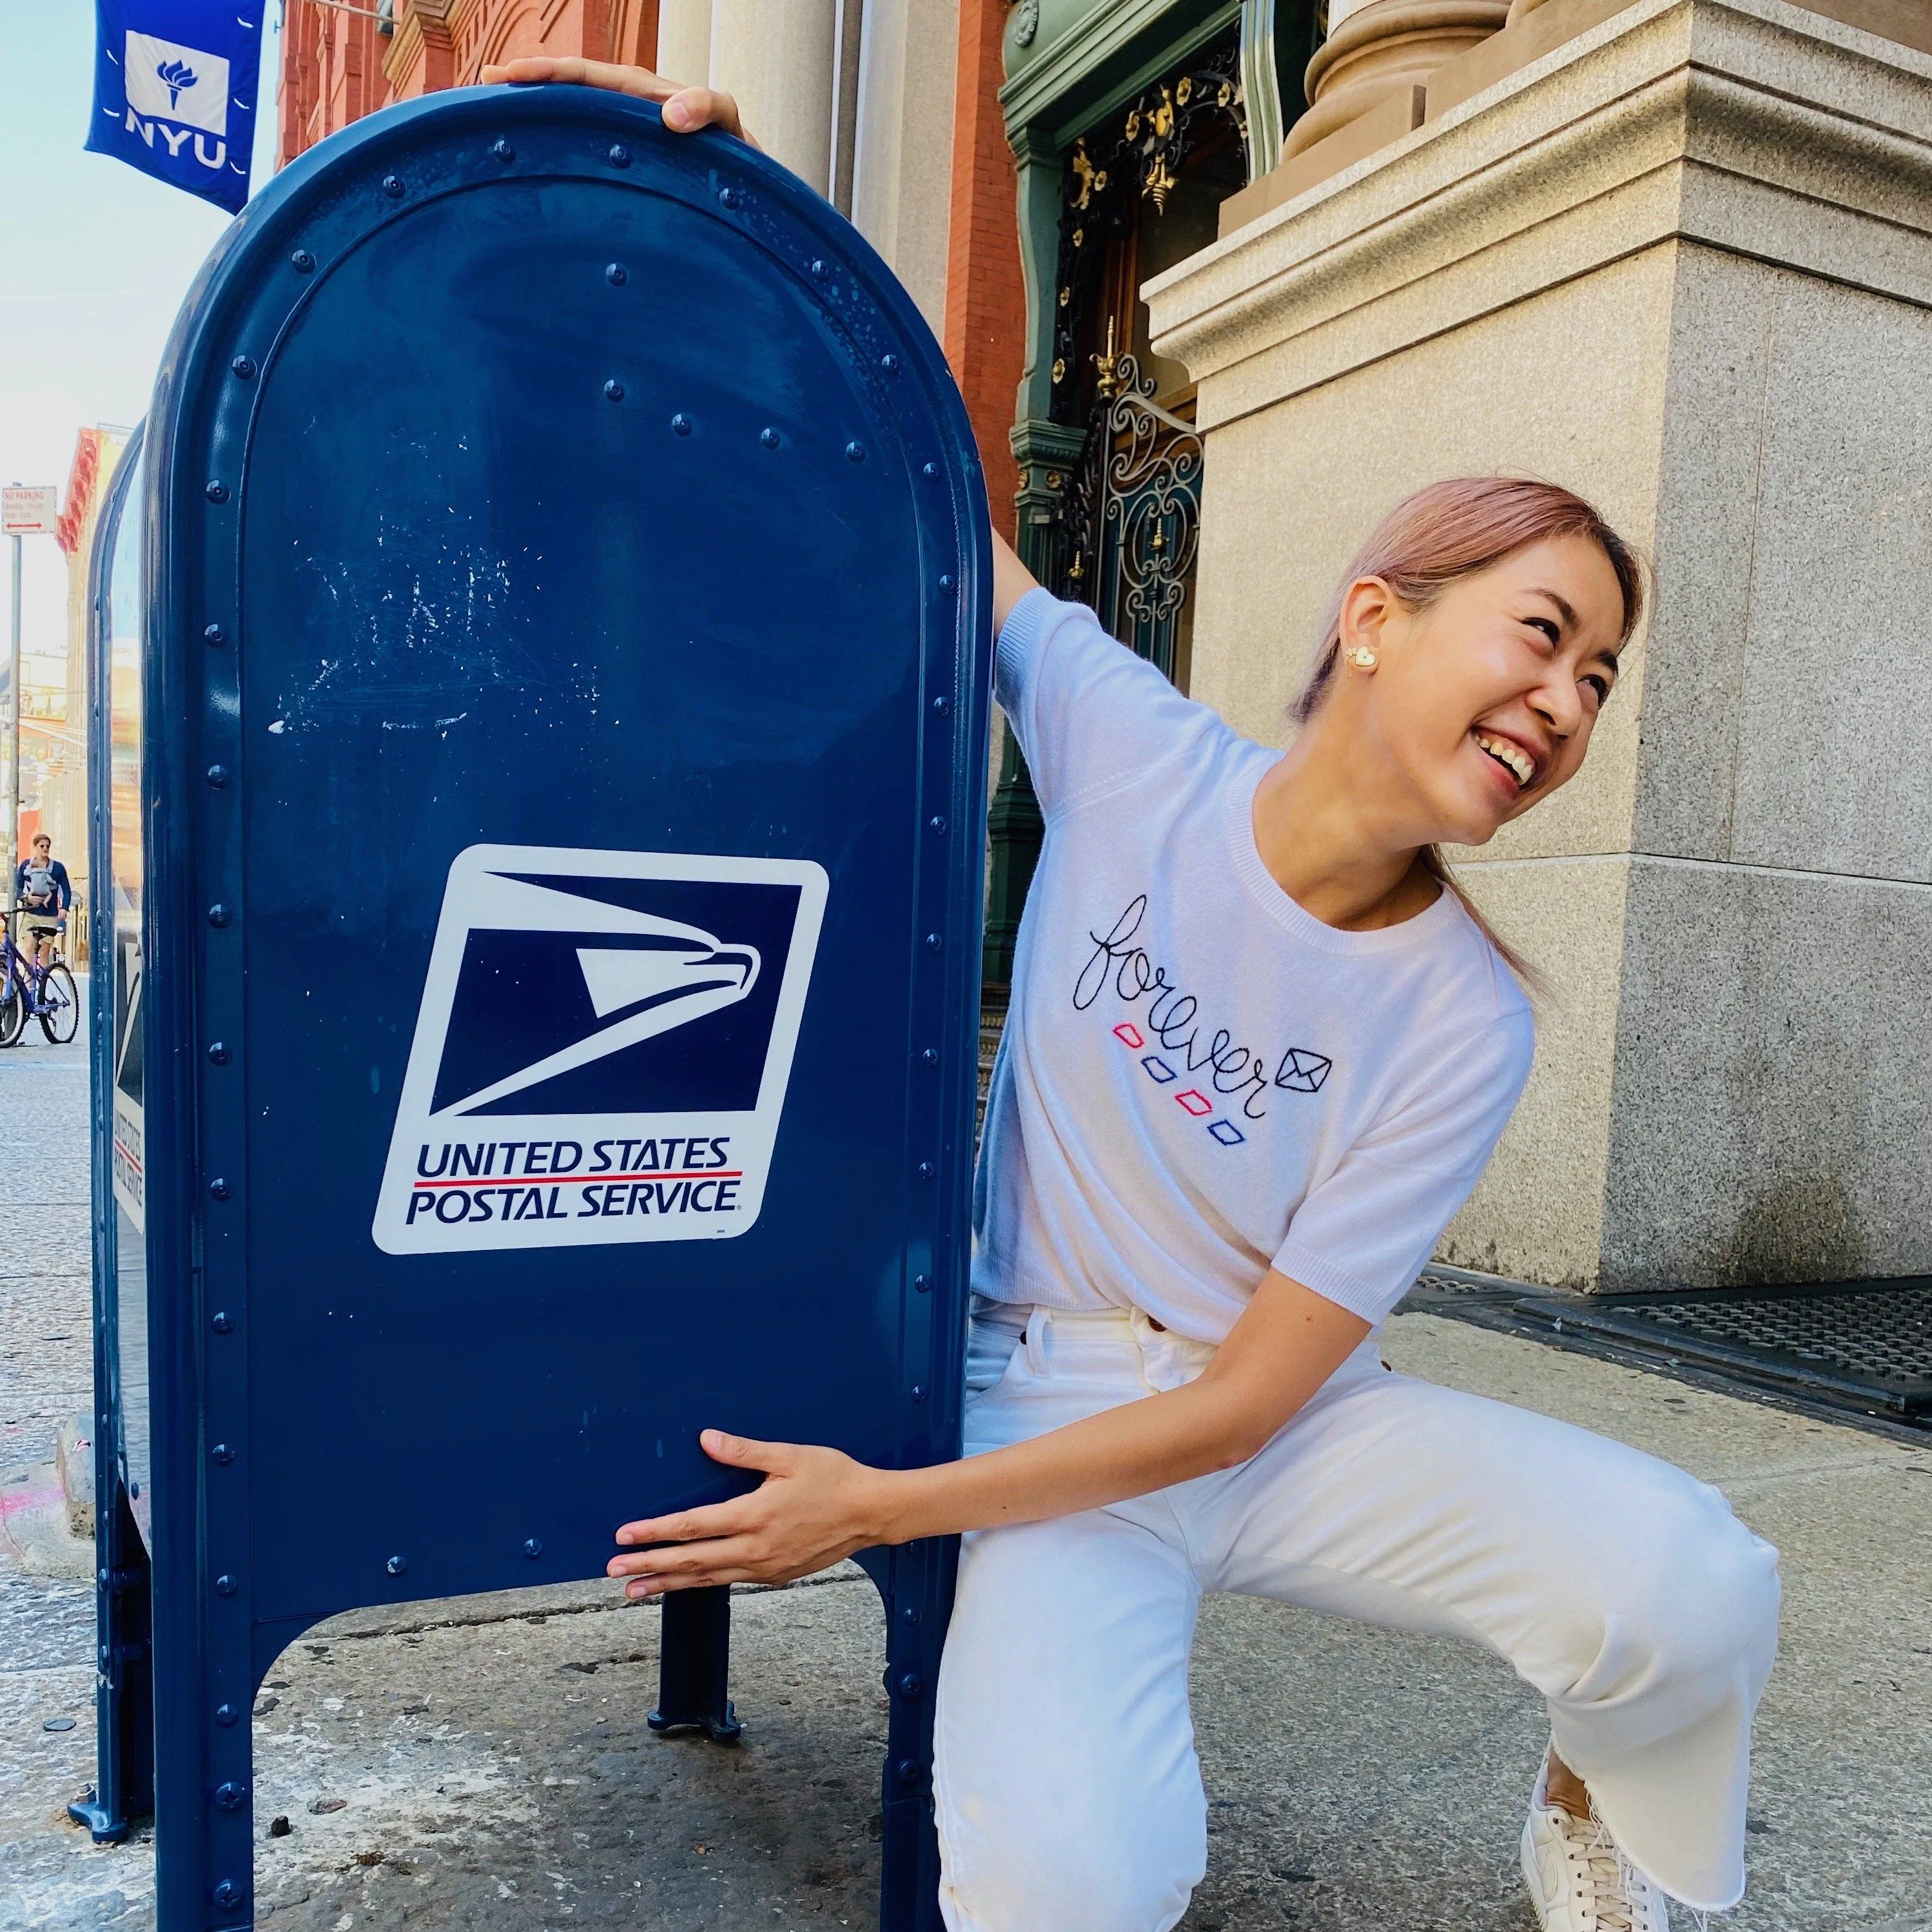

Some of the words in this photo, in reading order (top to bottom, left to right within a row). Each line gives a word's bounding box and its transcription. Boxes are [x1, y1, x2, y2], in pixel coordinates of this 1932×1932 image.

[124, 106, 226, 170] NYU
[5, 492, 14, 500] NO
[16, 491, 44, 500] PARKING
[1073, 894, 1268, 1120] forever
[416, 1140, 583, 1178] UNITED
[589, 1137, 730, 1172] STATES
[405, 1186, 568, 1225] POSTAL
[577, 1180, 741, 1218] SERVICE
